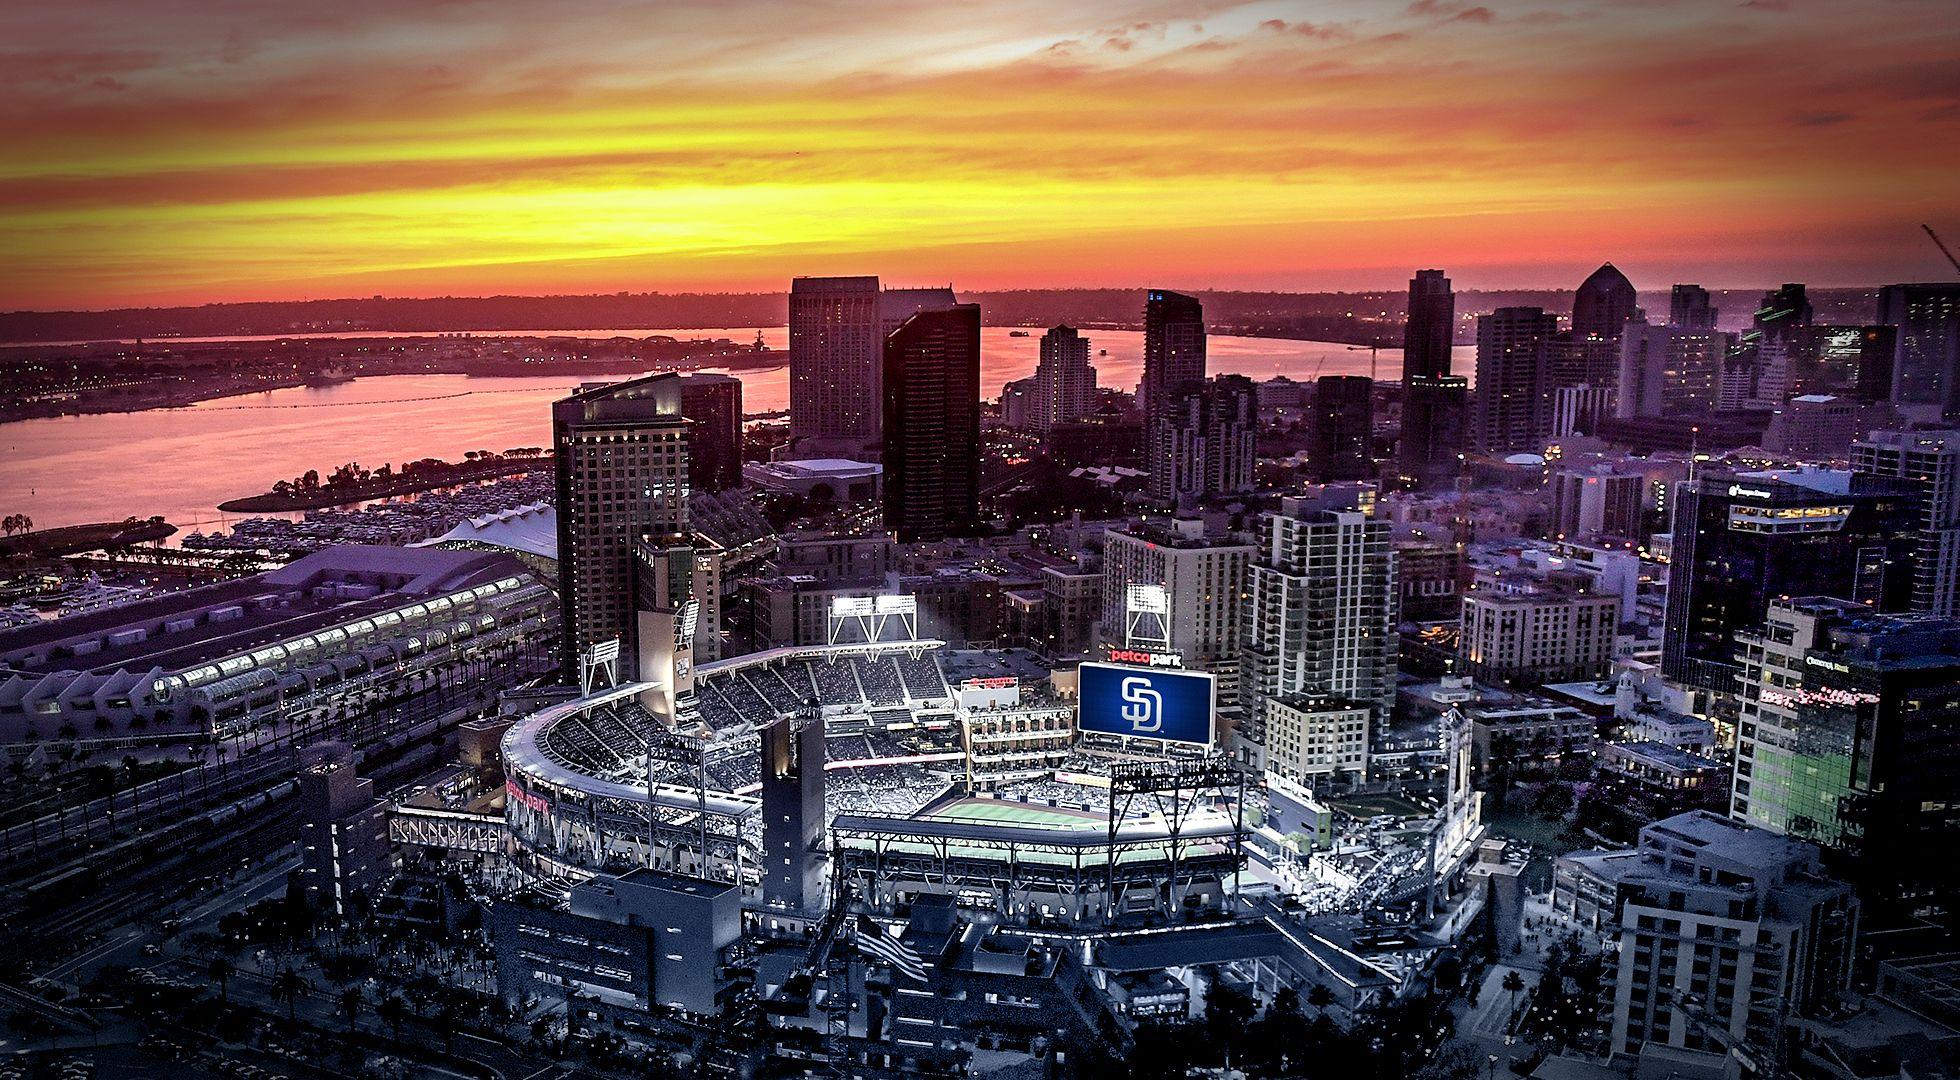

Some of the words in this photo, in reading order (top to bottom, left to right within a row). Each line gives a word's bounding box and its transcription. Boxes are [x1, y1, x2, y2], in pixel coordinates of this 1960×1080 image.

[969, 716, 1002, 724] WESTERN
[1005, 714, 1028, 722] METAL
[1030, 712, 1058, 720] SUPPLY
[1121, 676, 1163, 733] SD
